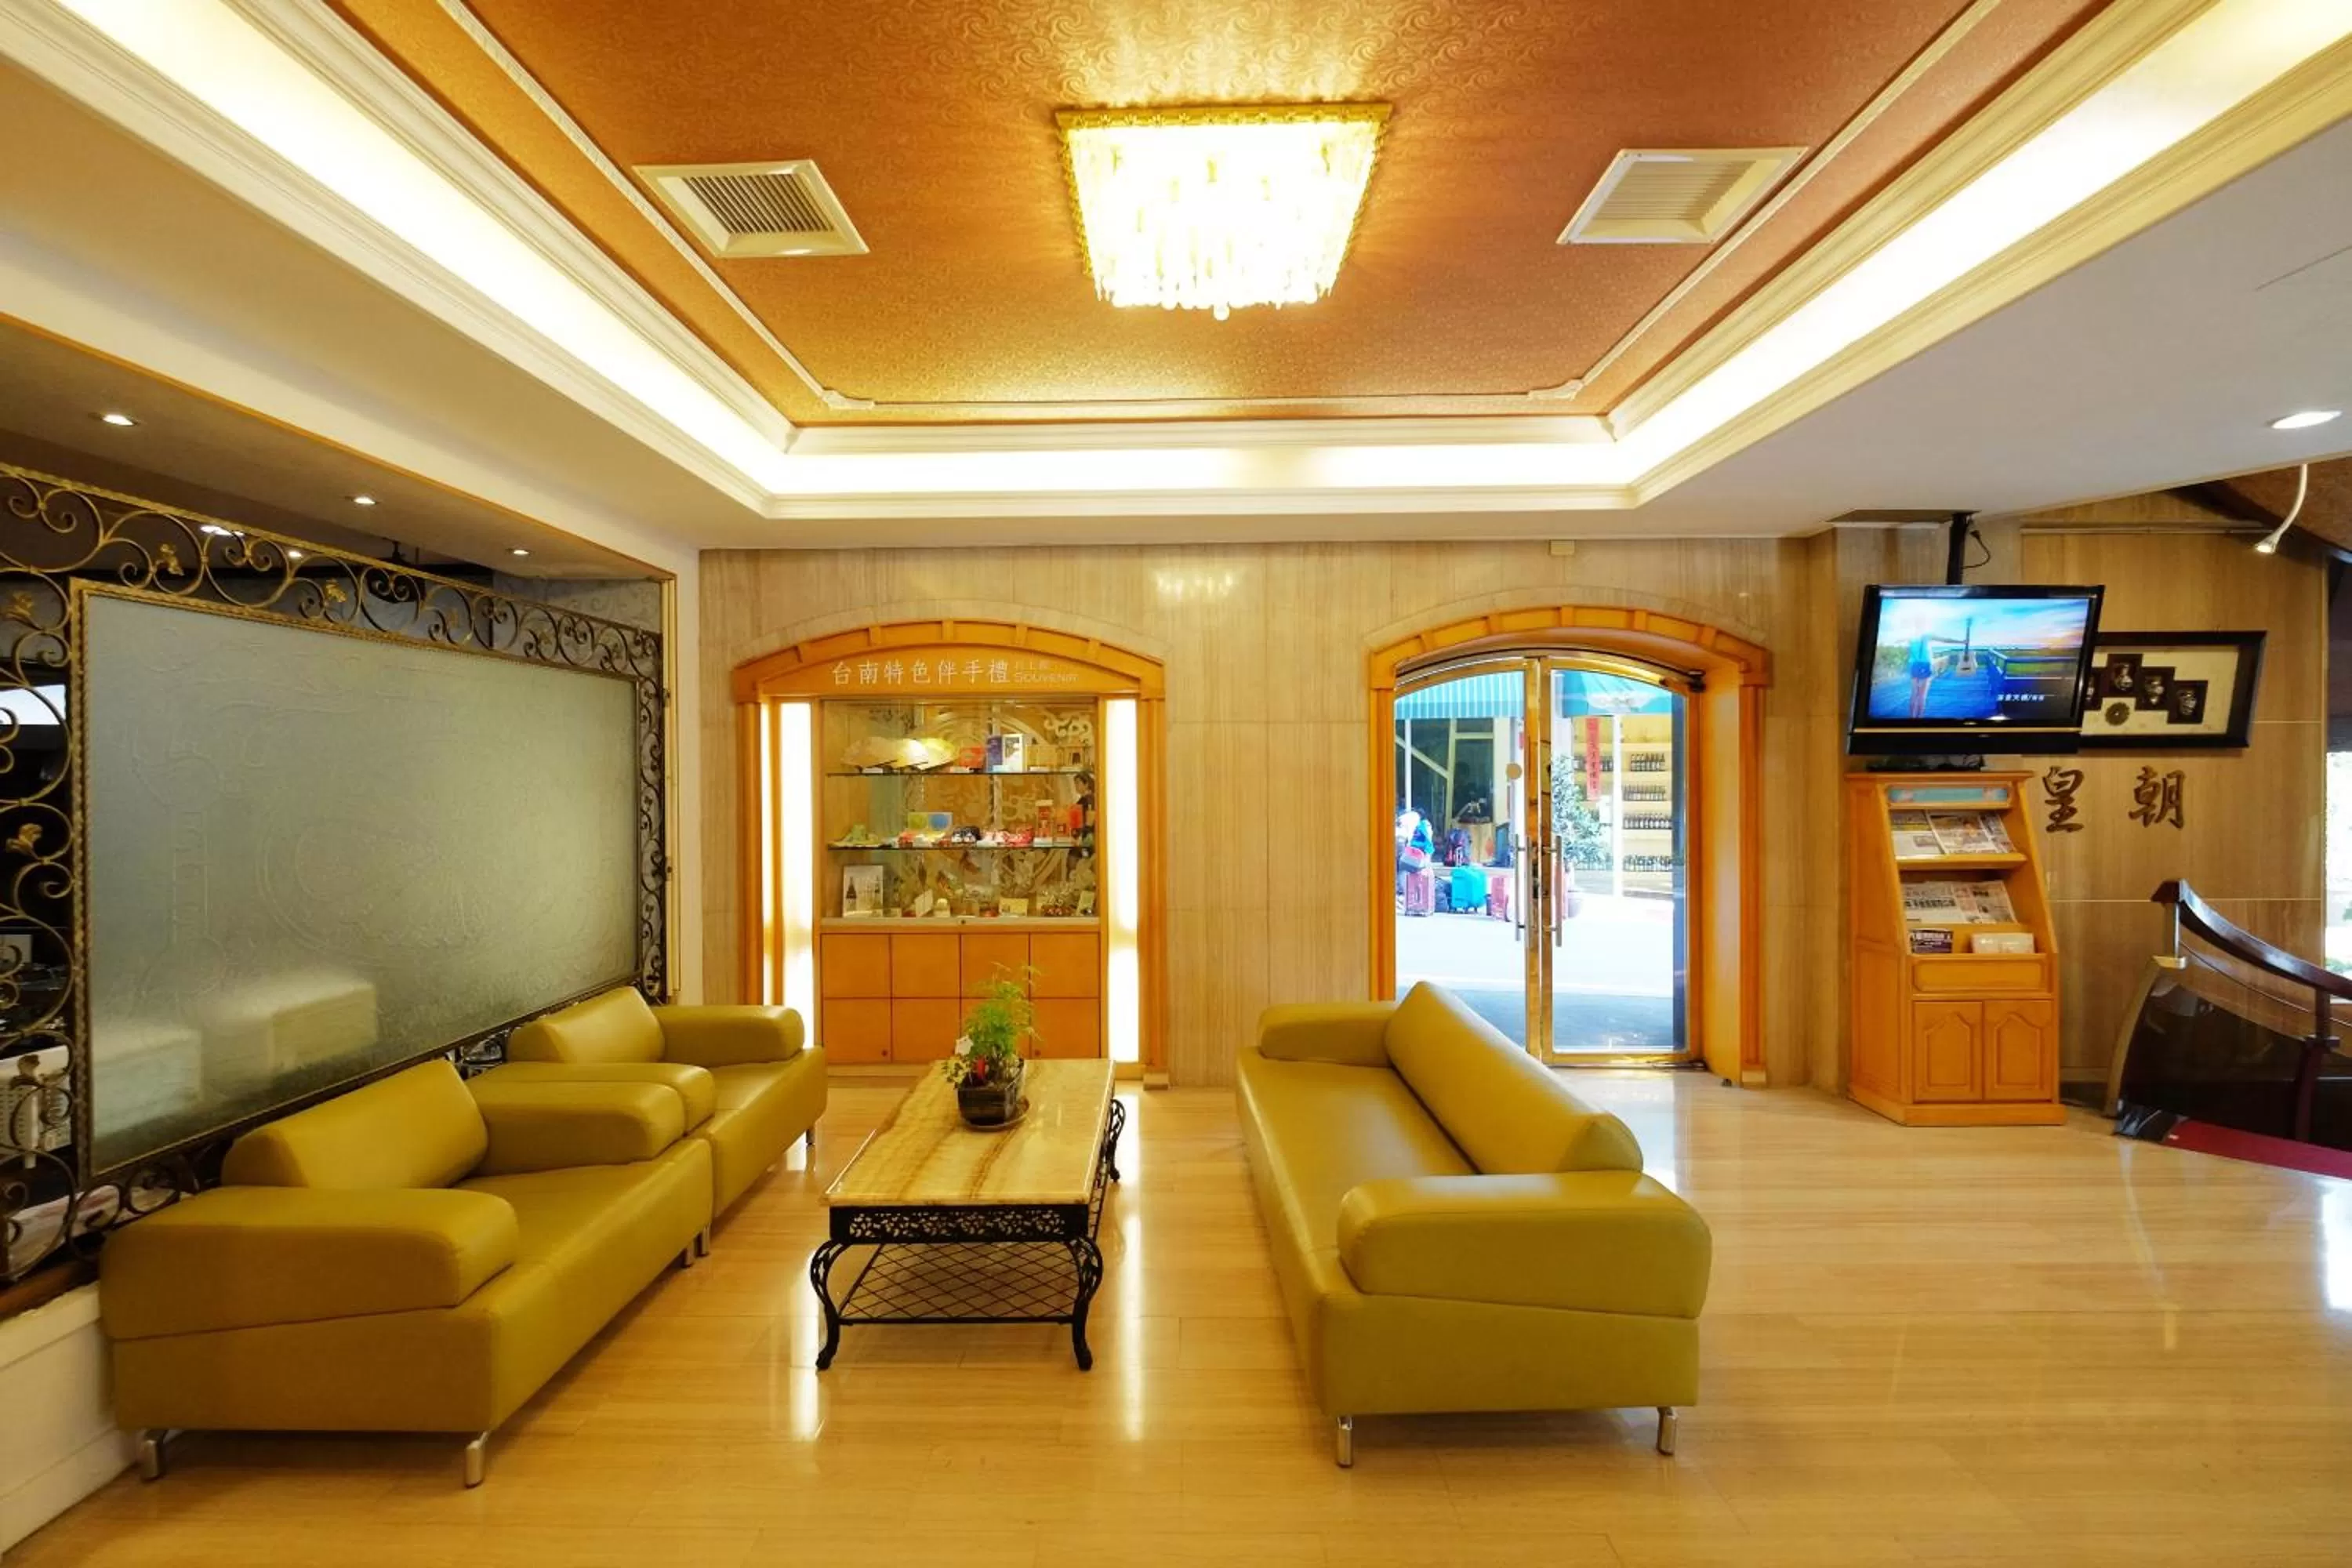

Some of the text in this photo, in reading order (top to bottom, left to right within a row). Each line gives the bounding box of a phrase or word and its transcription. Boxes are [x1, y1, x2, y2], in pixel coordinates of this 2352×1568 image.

[832, 659, 1011, 684] 台南特色伴手禮
[2042, 765, 2186, 833] 皇朝
